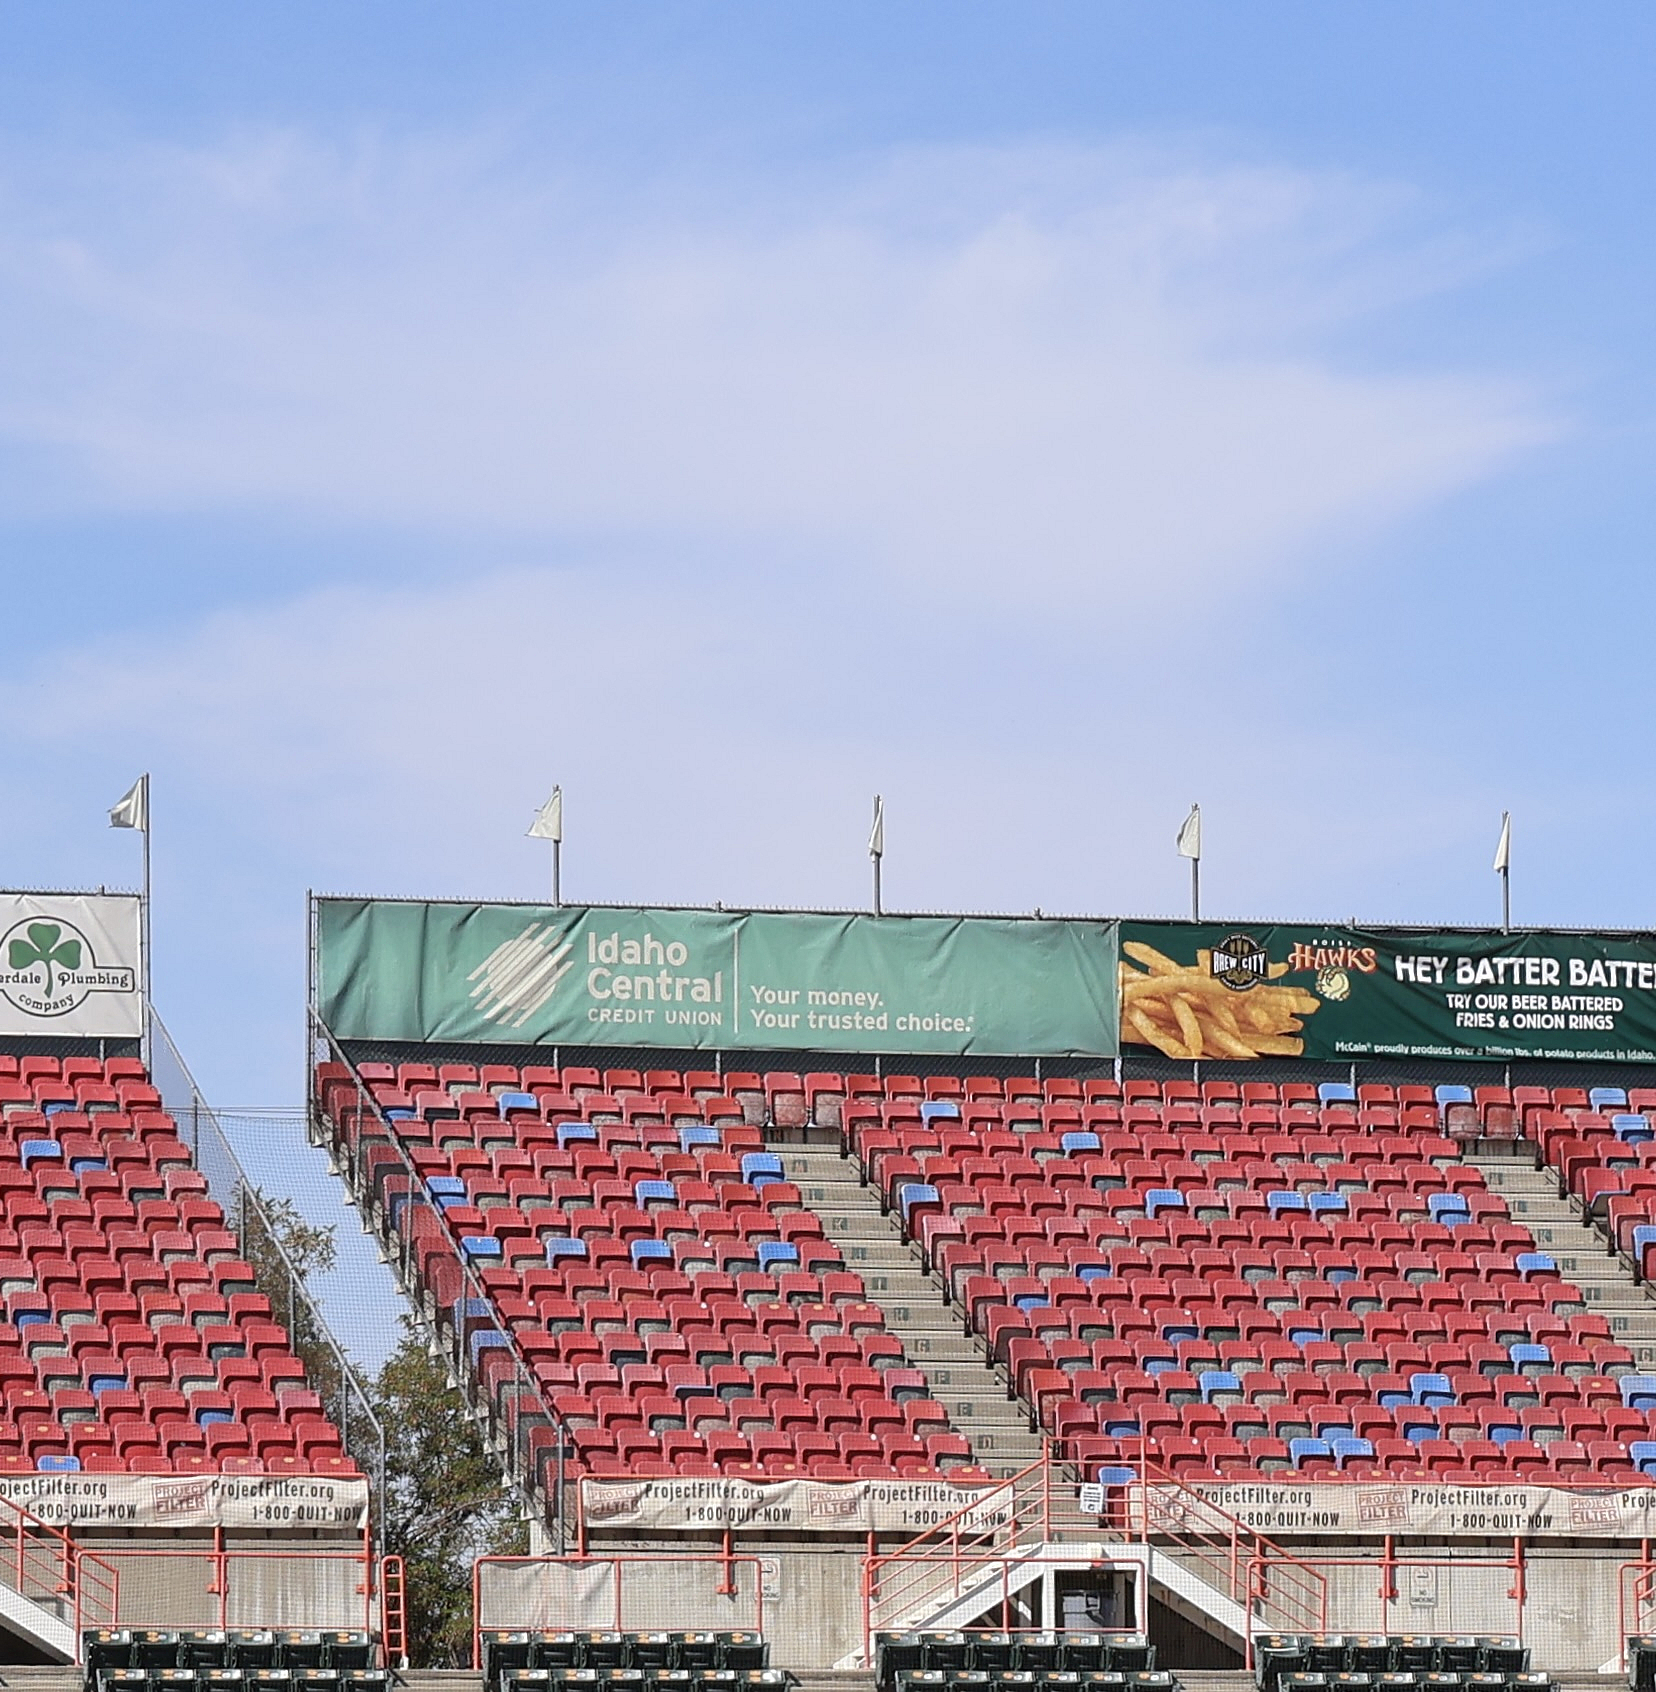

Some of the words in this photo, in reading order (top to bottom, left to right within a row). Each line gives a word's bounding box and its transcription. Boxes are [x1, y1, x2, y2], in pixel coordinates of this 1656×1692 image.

[587, 931, 688, 965] Idaho
[1213, 950, 1238, 974] BREW
[1242, 951, 1266, 975] CITY
[1287, 942, 1378, 974] HAWKS
[57, 972, 128, 987] Plumbing
[1395, 955, 1449, 984] HEY
[1456, 957, 1561, 986] BATTER
[587, 966, 722, 1003] Central
[18, 993, 74, 1012] company
[750, 985, 800, 1005] Your
[808, 988, 884, 1011] money.
[1446, 993, 1472, 1009] TRY
[1475, 994, 1508, 1010] OUR
[1512, 995, 1548, 1011] BEER
[1551, 996, 1624, 1012] BATTERED
[588, 1008, 655, 1025] CREDIT
[666, 1011, 722, 1026] UNION
[750, 1009, 800, 1029] Your
[808, 1010, 888, 1031] trusted
[1456, 1013, 1495, 1028] FRIES
[1498, 1015, 1510, 1029] &
[1512, 1013, 1565, 1030] ONION
[1569, 1014, 1614, 1030] RINGS
[1374, 1043, 1409, 1055] proudly
[1411, 1045, 1453, 1056] produces
[154, 1485, 205, 1498] PROJECT
[212, 1480, 334, 1502] ProjectFilter.org
[645, 1481, 764, 1502] ProjectFilter.org
[1358, 1493, 1404, 1505] PROJECT
[1411, 1489, 1527, 1509] ProjectFilter.org
[156, 1497, 205, 1513] FILTER
[252, 1505, 362, 1520] 1-800-QUIT-NOW
[685, 1507, 792, 1522] 1-800-QUIT-NOW
[1360, 1506, 1405, 1520] FILTER
[1450, 1513, 1552, 1528] 1-800-QUIT-NOW
